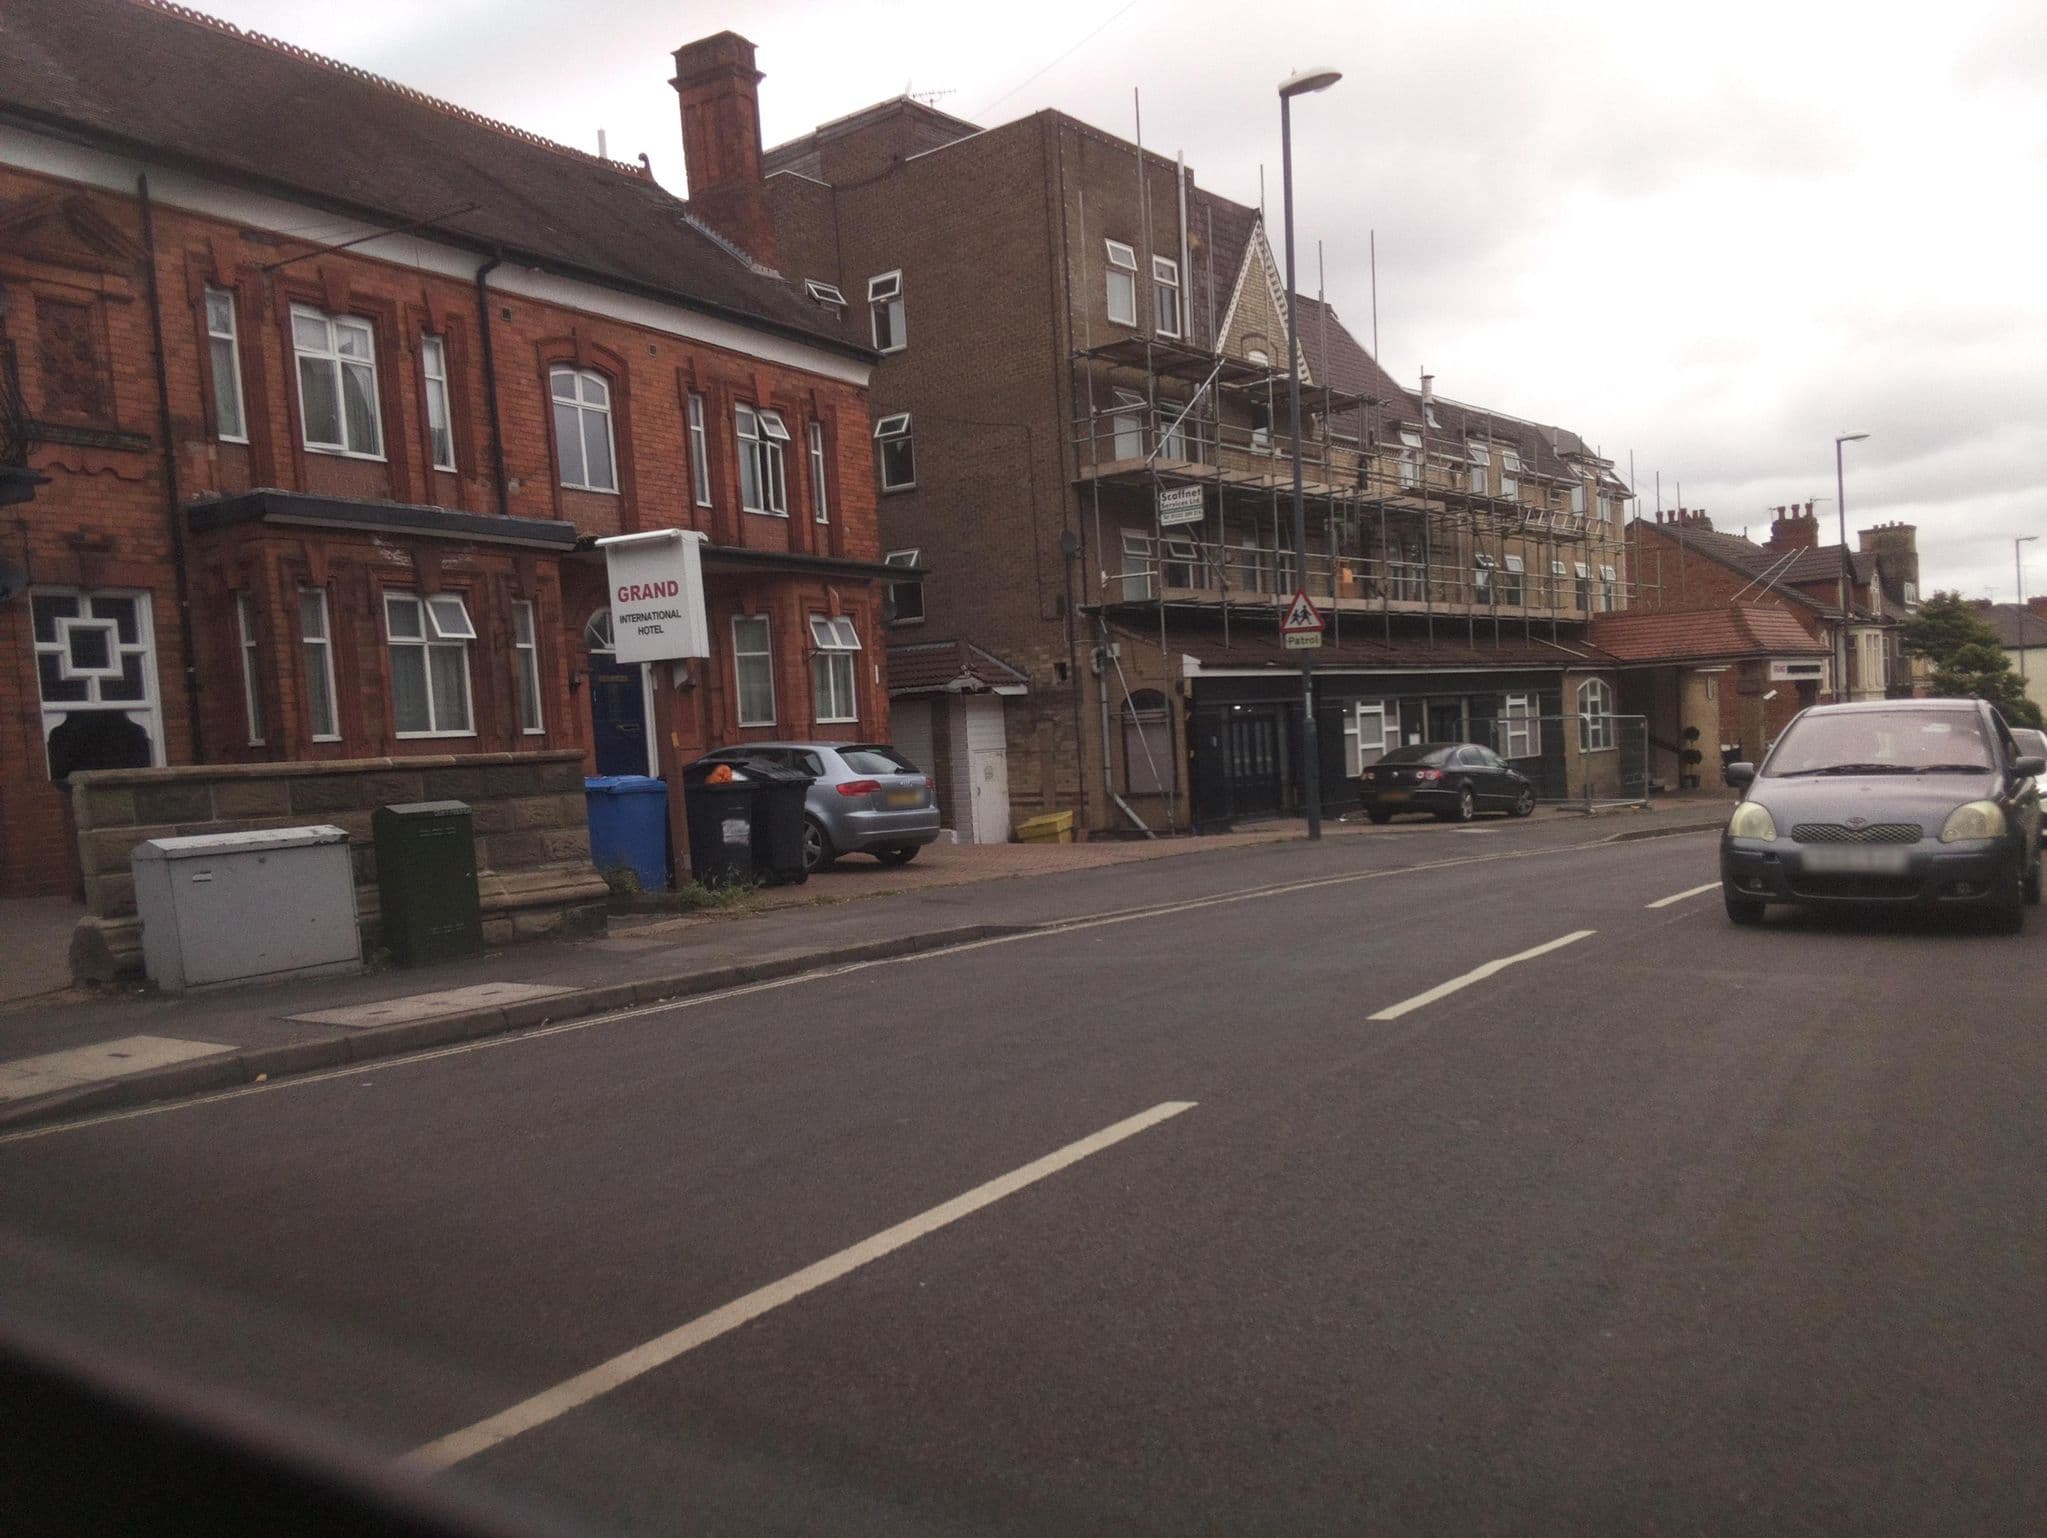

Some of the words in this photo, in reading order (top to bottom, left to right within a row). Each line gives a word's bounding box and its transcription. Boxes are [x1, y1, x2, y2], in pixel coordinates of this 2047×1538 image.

[1161, 488, 1200, 501] Scaffnet
[618, 580, 679, 602] GRAND
[619, 609, 682, 624] INTERNATIONAL
[638, 624, 664, 635] HOTEL
[1288, 634, 1319, 645] Patrol
